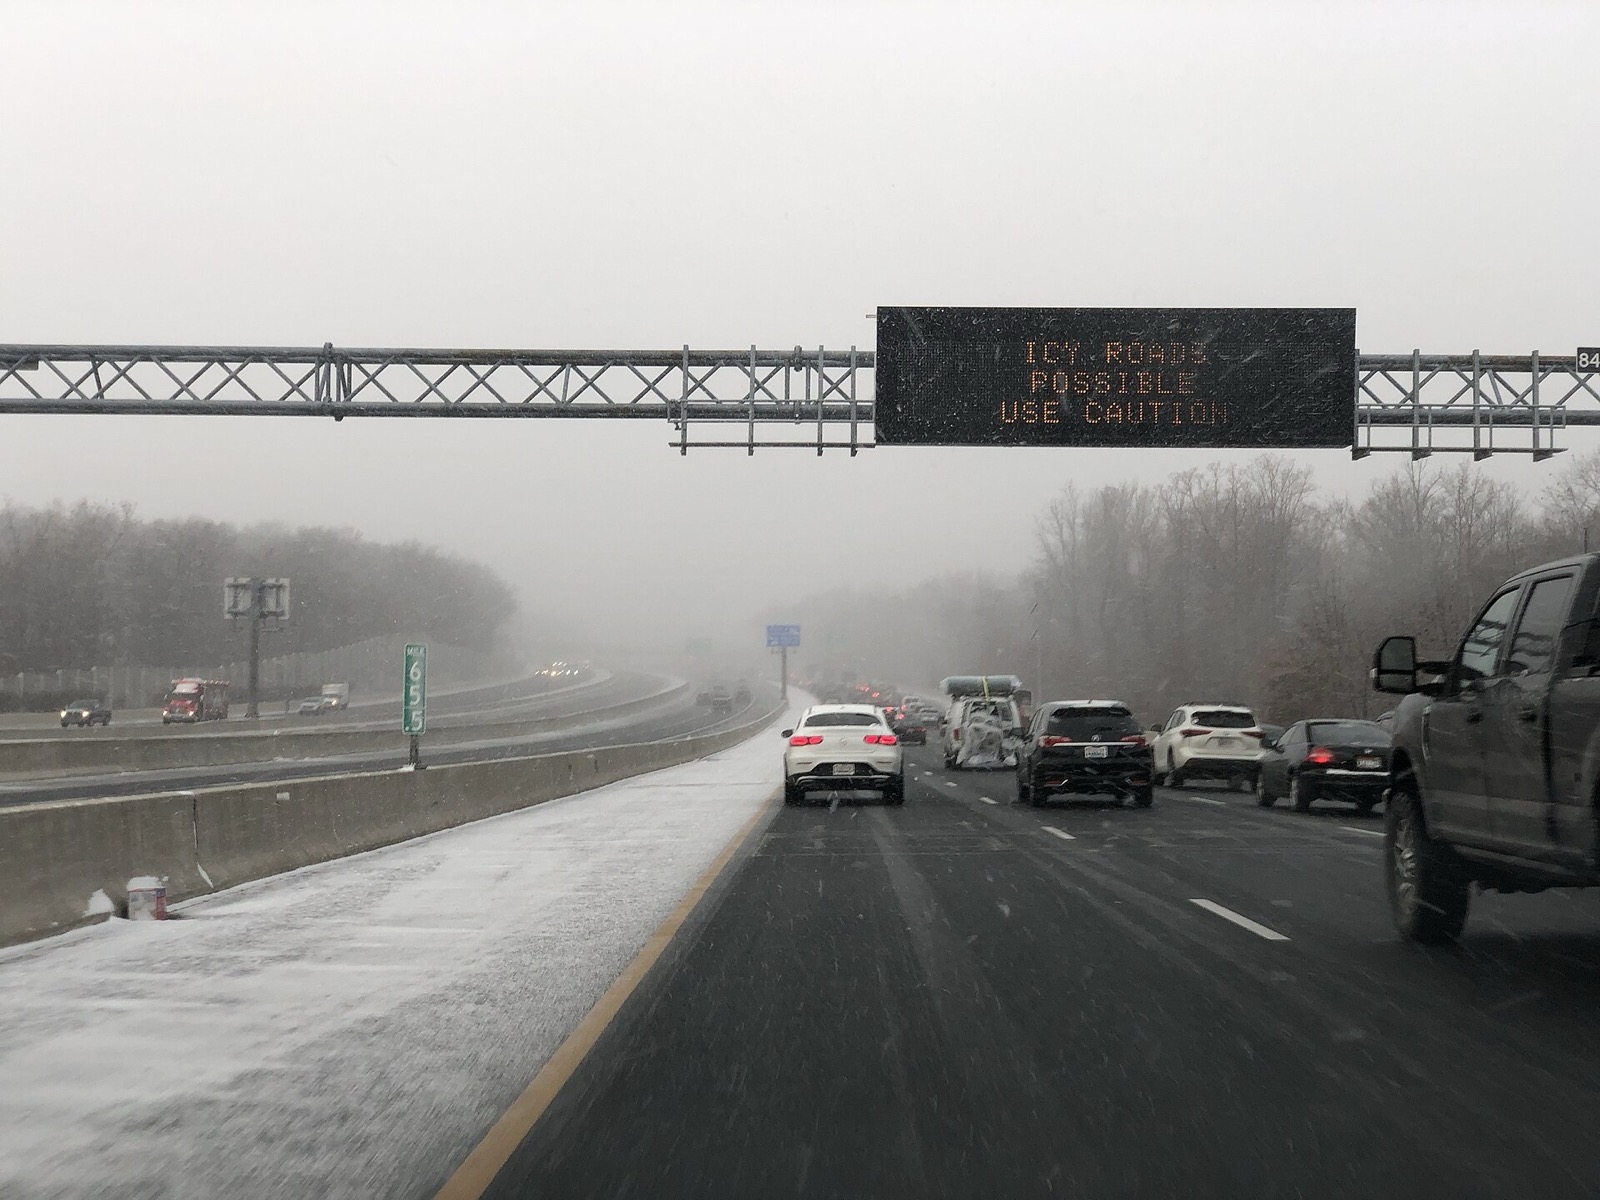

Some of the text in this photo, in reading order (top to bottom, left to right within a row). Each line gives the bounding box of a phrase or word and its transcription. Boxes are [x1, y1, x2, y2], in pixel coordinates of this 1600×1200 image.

[1026, 341, 1207, 365] ICY ROADS
[1578, 352, 1600, 368] 84
[1030, 371, 1195, 394] POSSIBLE
[1001, 401, 1228, 424] USE CAUTION
